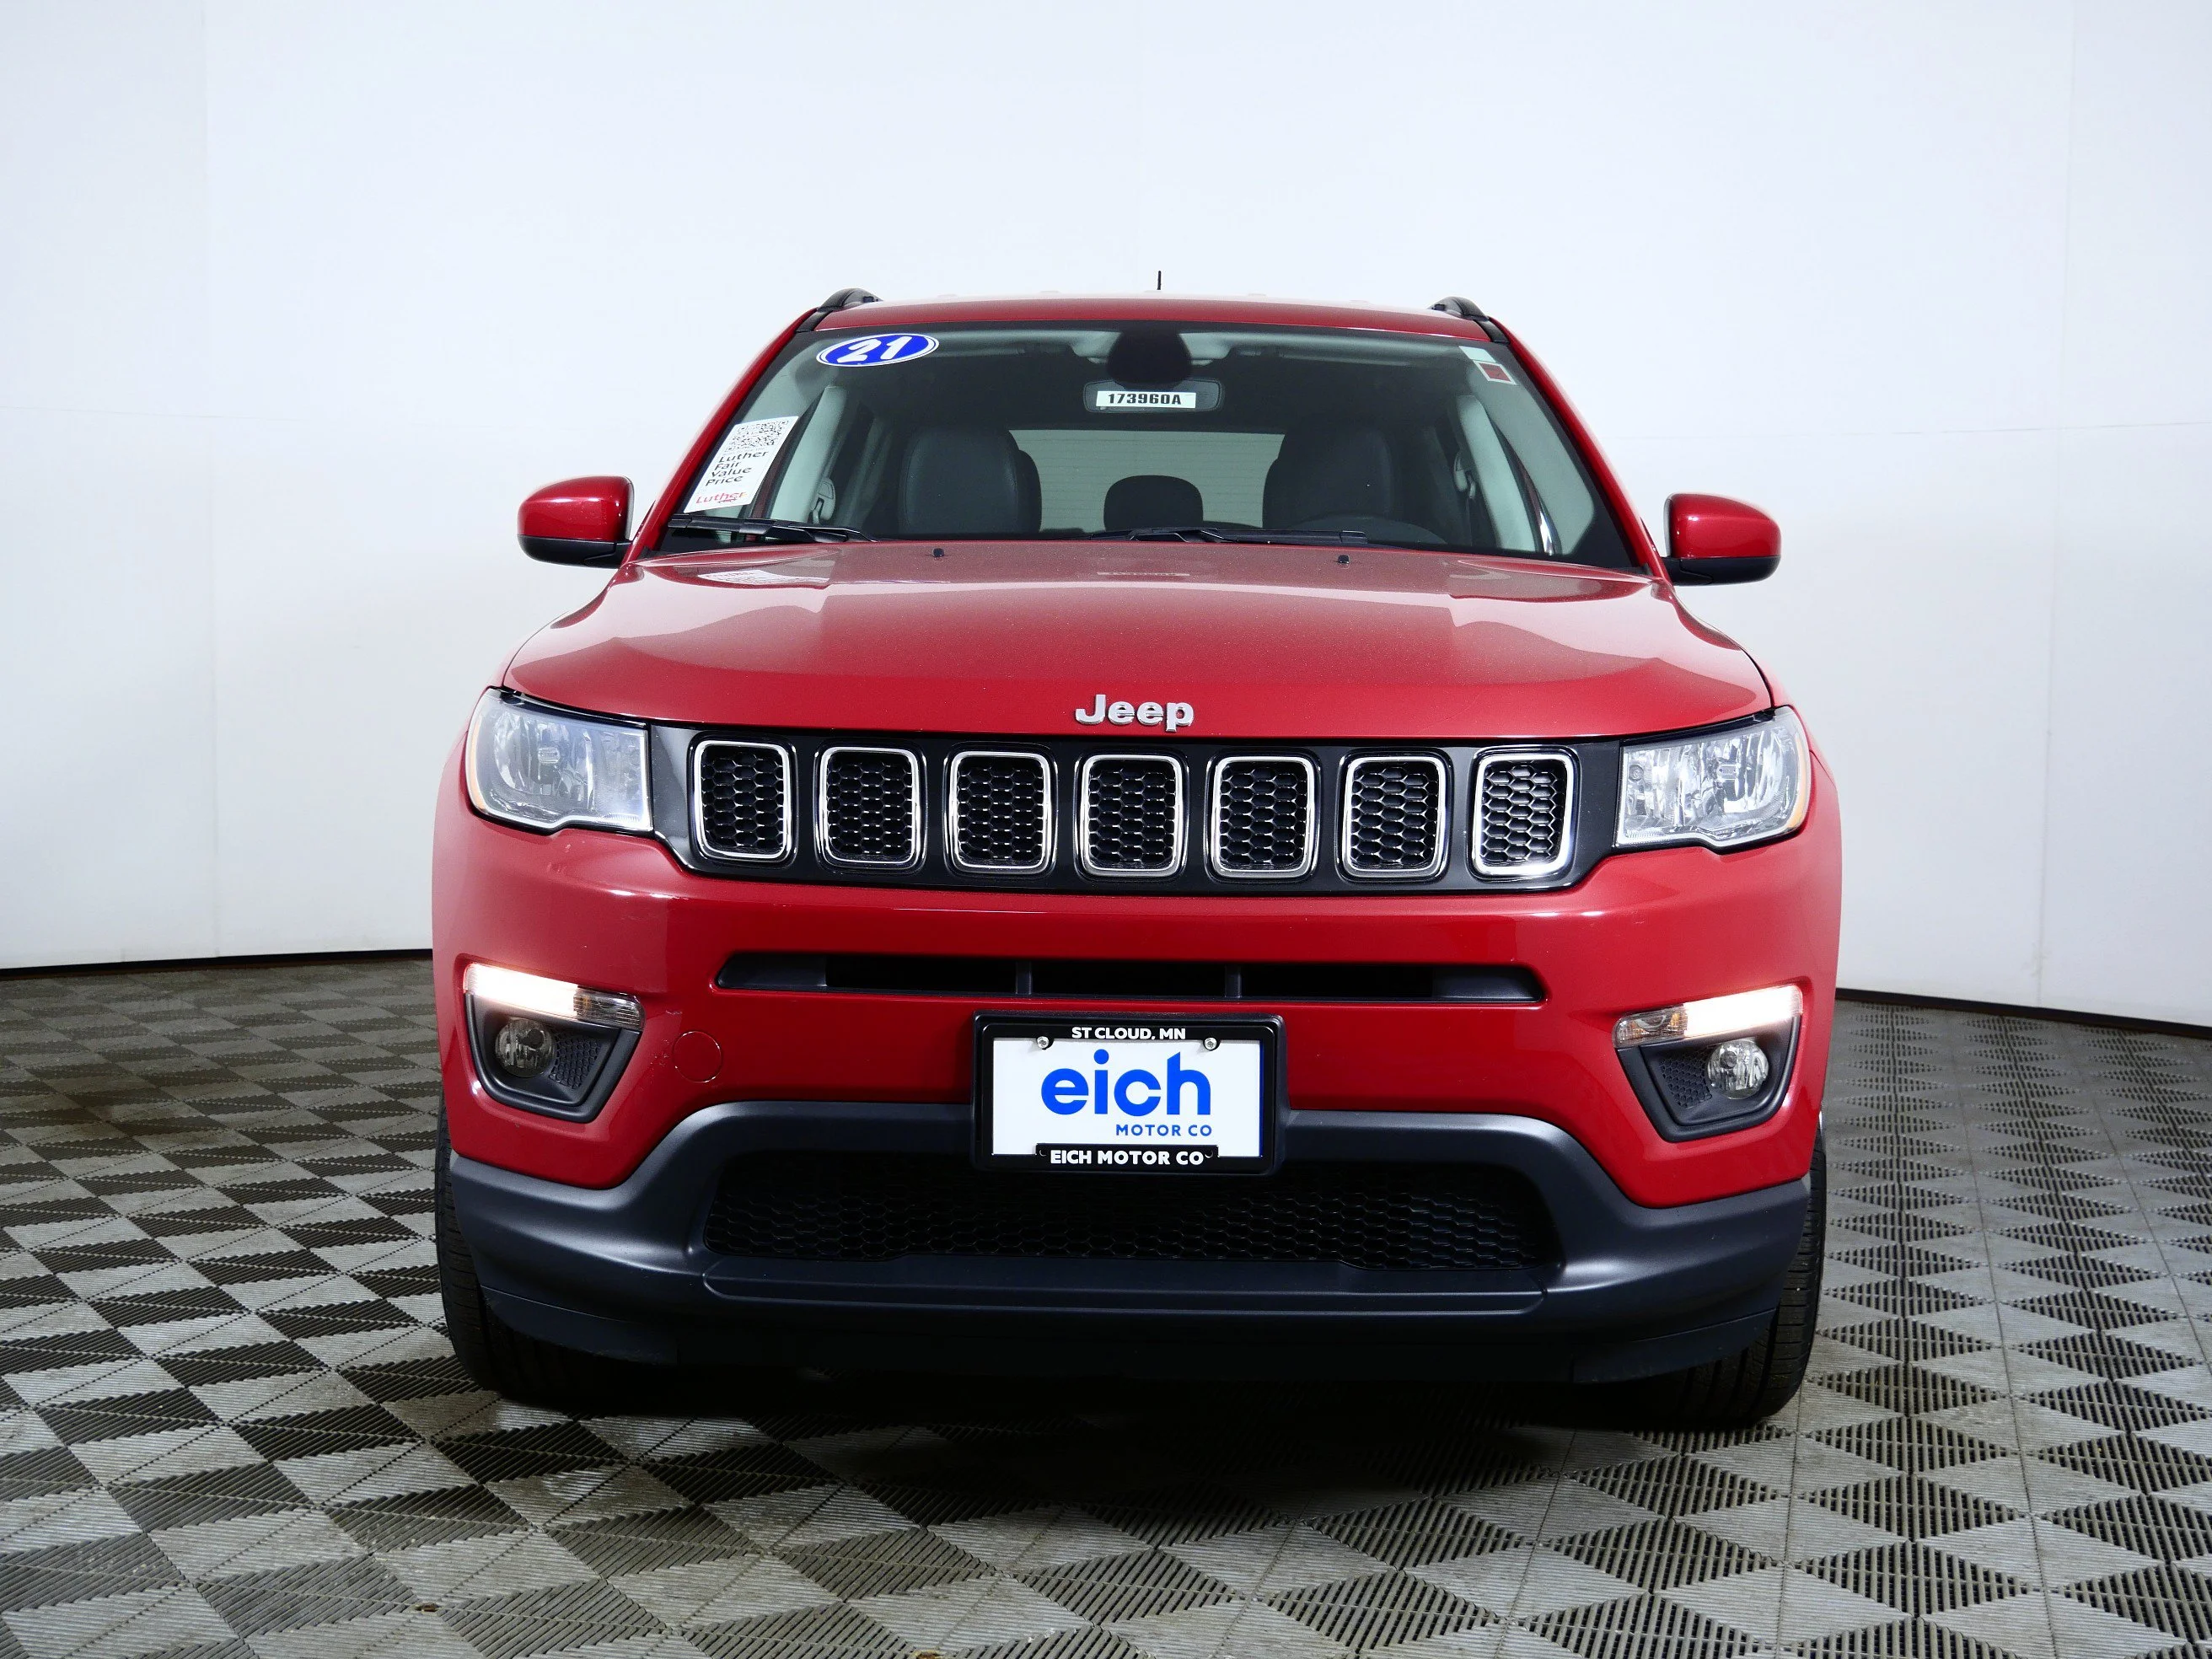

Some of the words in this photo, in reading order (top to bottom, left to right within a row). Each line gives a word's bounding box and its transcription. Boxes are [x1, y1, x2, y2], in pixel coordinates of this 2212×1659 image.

[837, 336, 912, 362] 21
[1109, 394, 1181, 405] 173960A
[719, 452, 769, 463] Luther
[715, 462, 741, 470] Fair
[711, 468, 752, 477] Value
[706, 476, 743, 486] Price
[696, 492, 747, 503] Luther
[1075, 694, 1195, 732] Jeep
[1072, 1027, 1092, 1039] ST
[1094, 1028, 1156, 1040] CLOUD,
[1160, 1028, 1185, 1039] MN
[1041, 1049, 1211, 1117] eich
[1116, 1125, 1181, 1136] MOTOR
[1188, 1125, 1212, 1136] CO
[1050, 1150, 1092, 1164] EICH
[1098, 1150, 1171, 1165] MOTOR
[1176, 1151, 1204, 1165] CO
